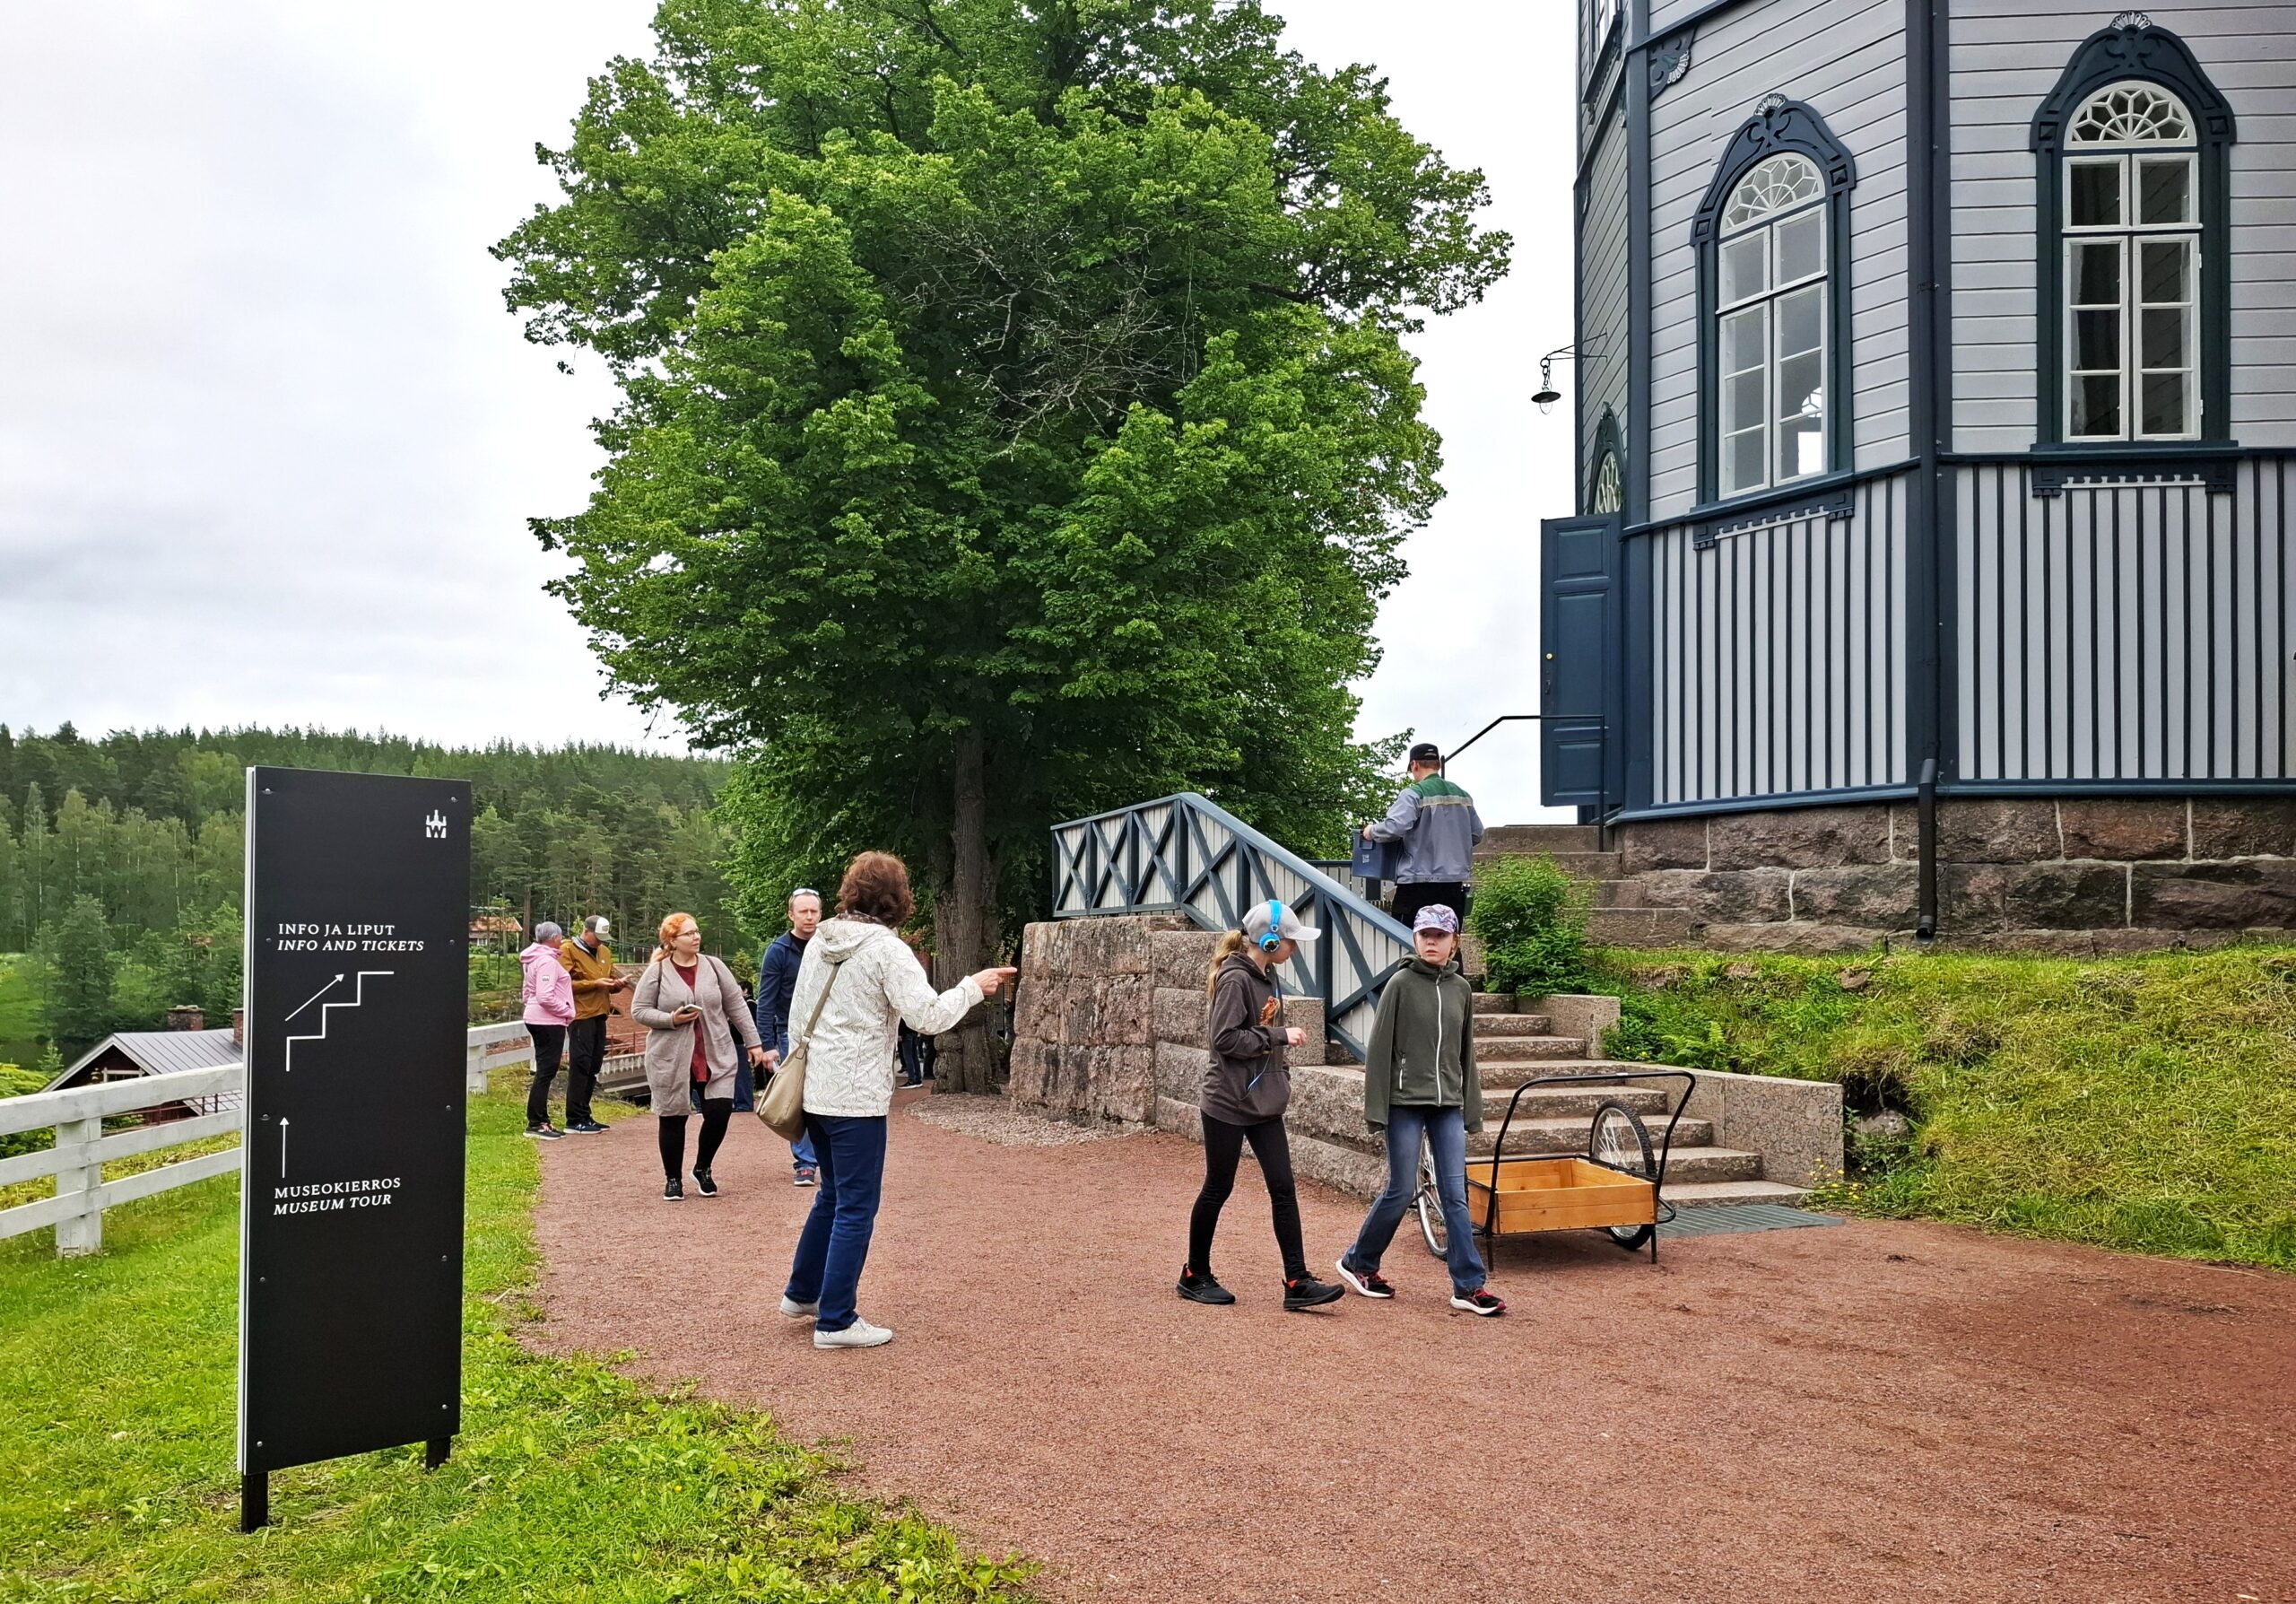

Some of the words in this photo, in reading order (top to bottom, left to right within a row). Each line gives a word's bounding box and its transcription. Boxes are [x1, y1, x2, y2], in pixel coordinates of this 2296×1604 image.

[278, 923, 319, 935] INFO
[324, 924, 343, 937] JA
[347, 924, 396, 936] LIPUT
[277, 940, 317, 951] INFO
[322, 940, 357, 951] AND
[361, 940, 424, 951] TICKETS
[274, 1177, 401, 1199] MUSEOKIERROS
[273, 1198, 344, 1216] MUSEUM
[349, 1194, 392, 1208] TOUR
